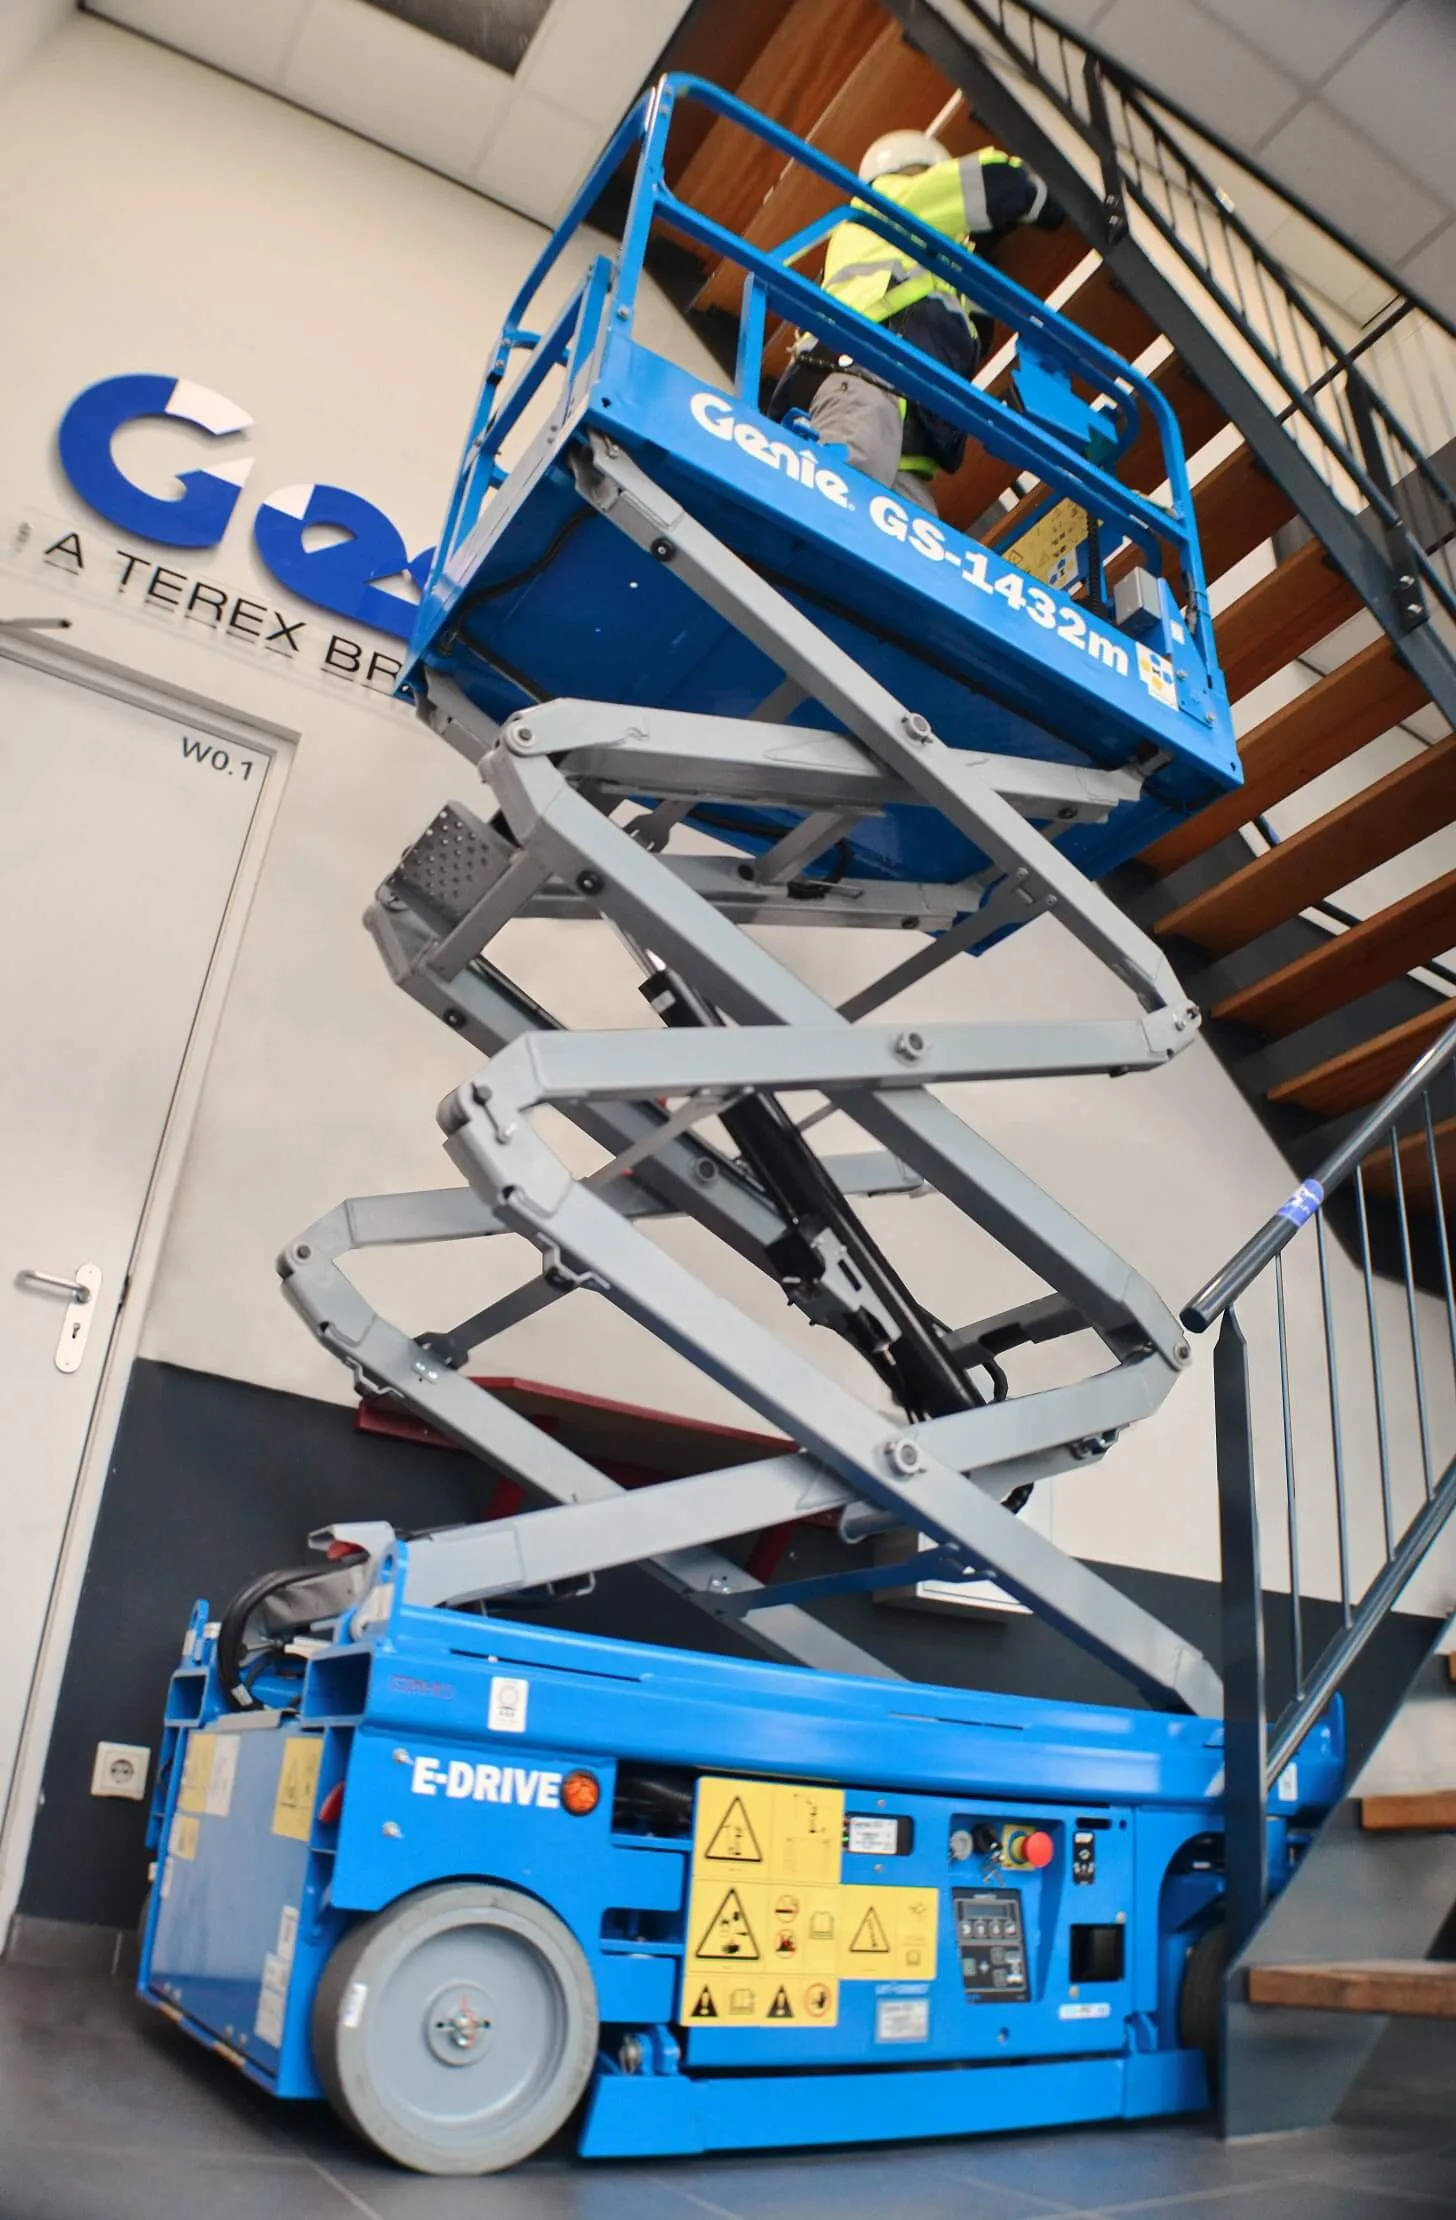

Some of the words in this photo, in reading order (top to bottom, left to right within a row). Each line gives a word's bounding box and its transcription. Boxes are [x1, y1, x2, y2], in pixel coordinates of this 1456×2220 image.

[58, 372, 437, 643] Ge
[690, 392, 850, 509] Genie
[869, 495, 1129, 677] GS-1432m
[44, 532, 85, 569] A
[117, 550, 307, 652] TEREX
[323, 635, 403, 683] BR
[183, 736, 254, 781] W0.1
[411, 1756, 562, 1809] E-DRIVE
